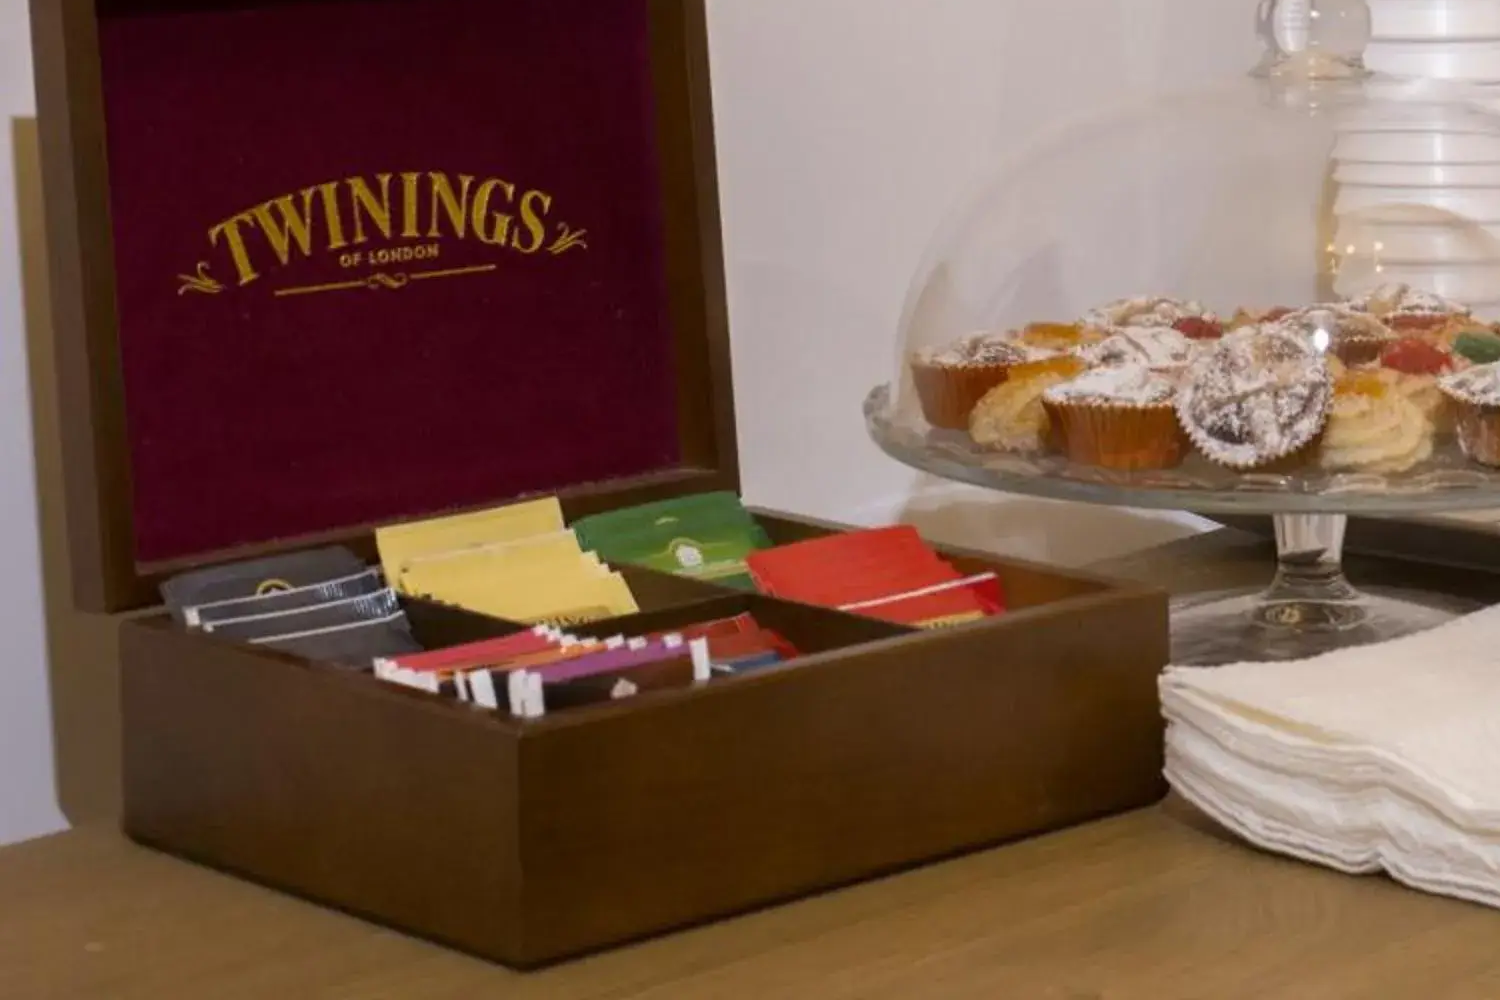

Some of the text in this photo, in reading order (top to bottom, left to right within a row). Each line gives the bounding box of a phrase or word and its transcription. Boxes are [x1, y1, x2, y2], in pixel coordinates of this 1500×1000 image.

[207, 171, 552, 287] TWININGS
[339, 243, 439, 268] OF LONDON
